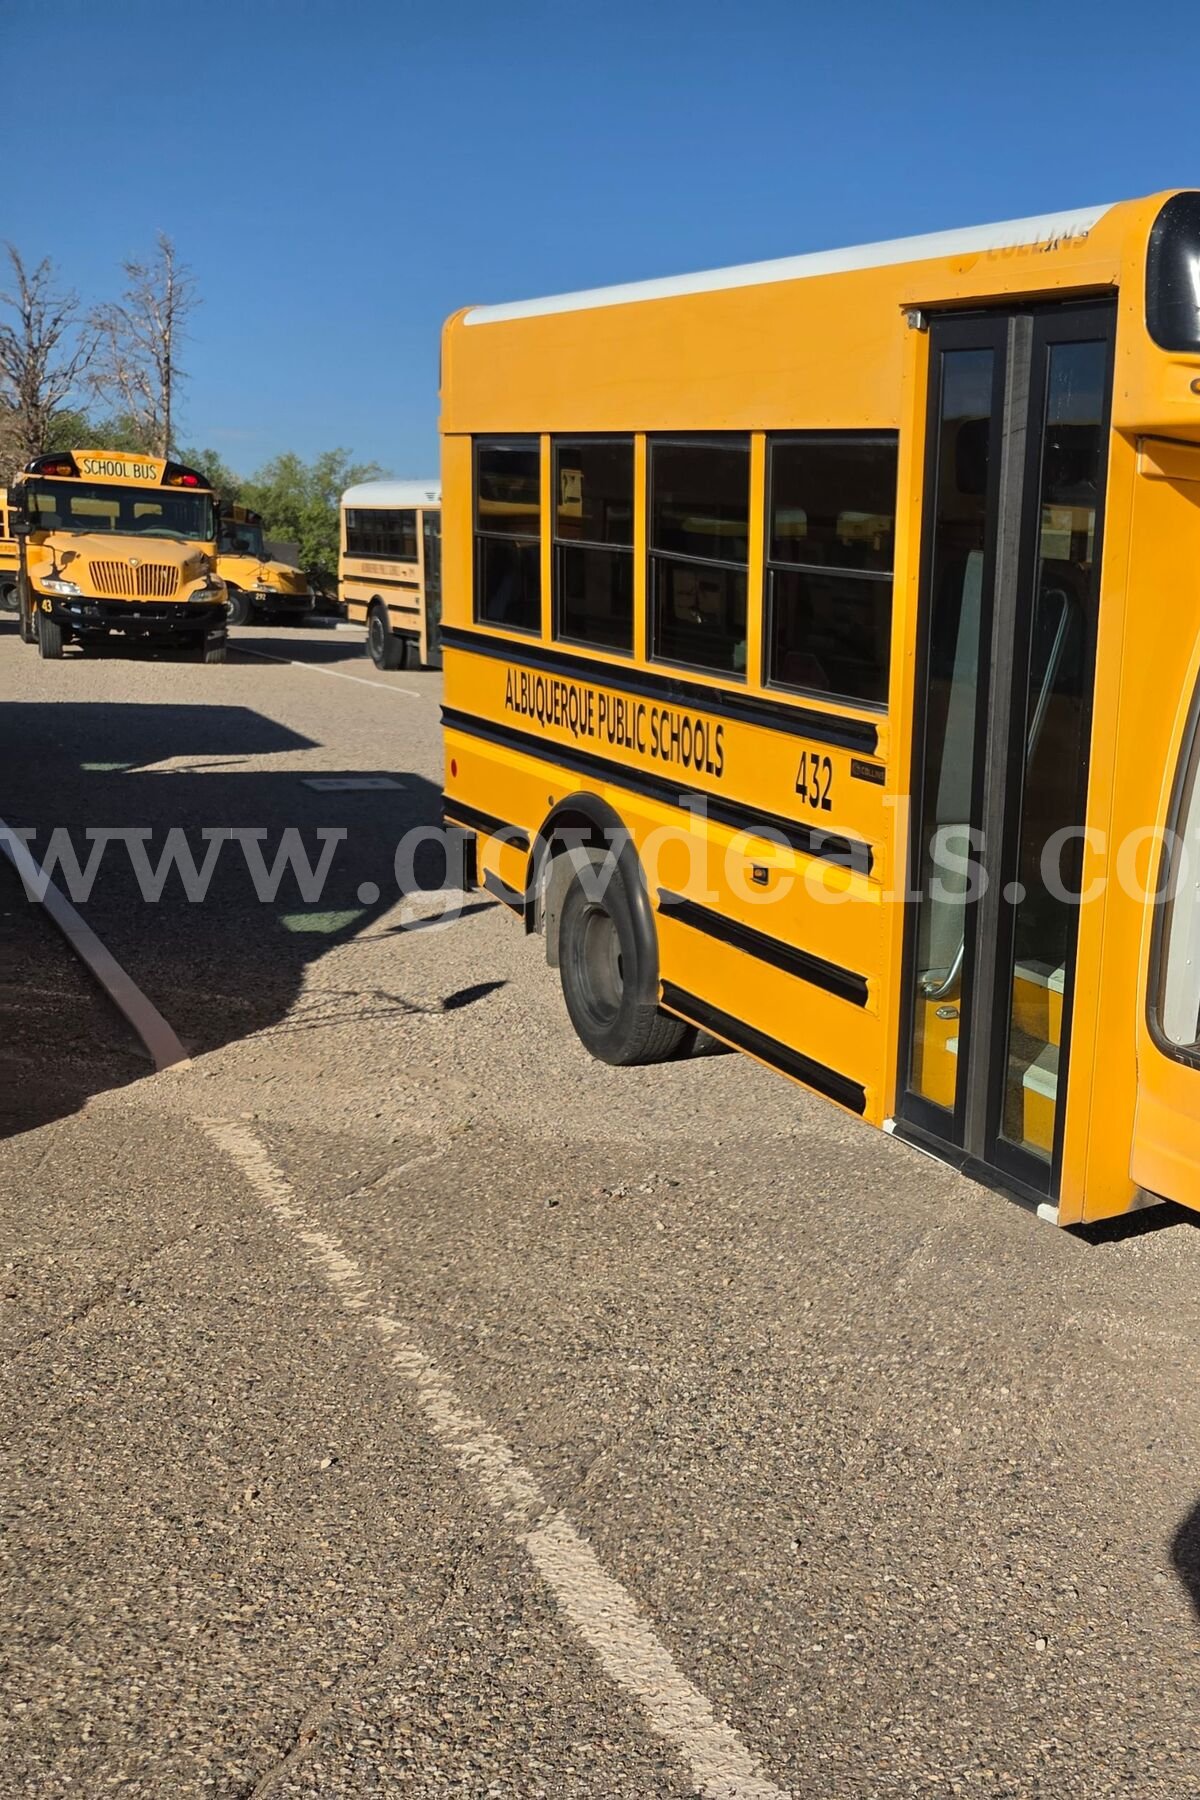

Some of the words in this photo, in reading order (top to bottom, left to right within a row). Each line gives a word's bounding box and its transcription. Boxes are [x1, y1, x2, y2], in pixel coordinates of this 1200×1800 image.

[83, 459, 130, 477] SCHOOL
[133, 464, 157, 480] BUS
[505, 668, 594, 739] ALBUQUERQUE
[598, 692, 646, 754] PUBLIC
[650, 706, 724, 778] SCHOOLS
[795, 750, 832, 812] 432
